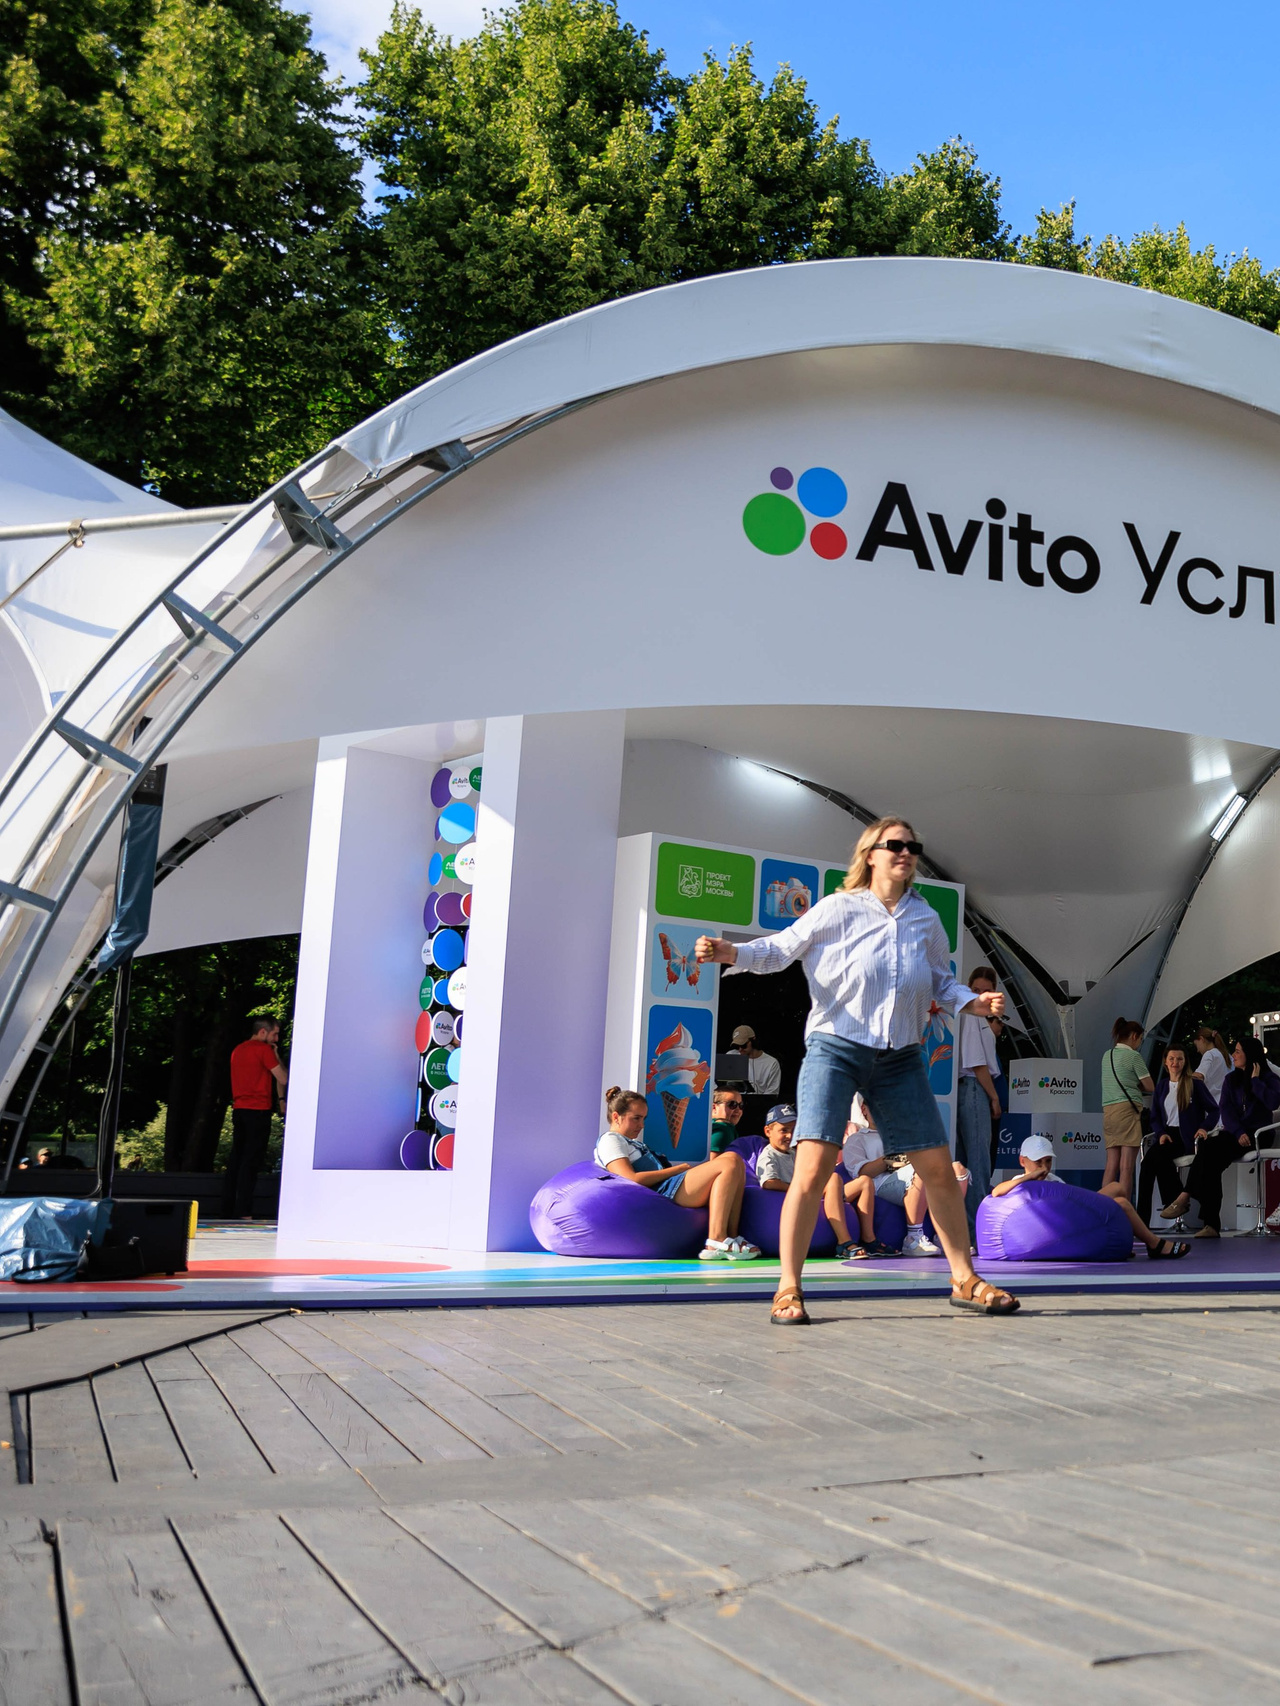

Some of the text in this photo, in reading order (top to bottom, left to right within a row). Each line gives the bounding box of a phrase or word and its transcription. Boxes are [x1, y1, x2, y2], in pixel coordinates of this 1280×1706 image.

[855, 481, 1101, 594] Avito
[706, 872, 731, 881] ПРОЕКТ
[706, 879, 724, 888] МЭРА
[706, 887, 734, 897] МОСКВЫ
[431, 1062, 447, 1071] ЛЕТ
[1050, 1077, 1077, 1088] Avito
[1074, 1132, 1102, 1143] Avito
